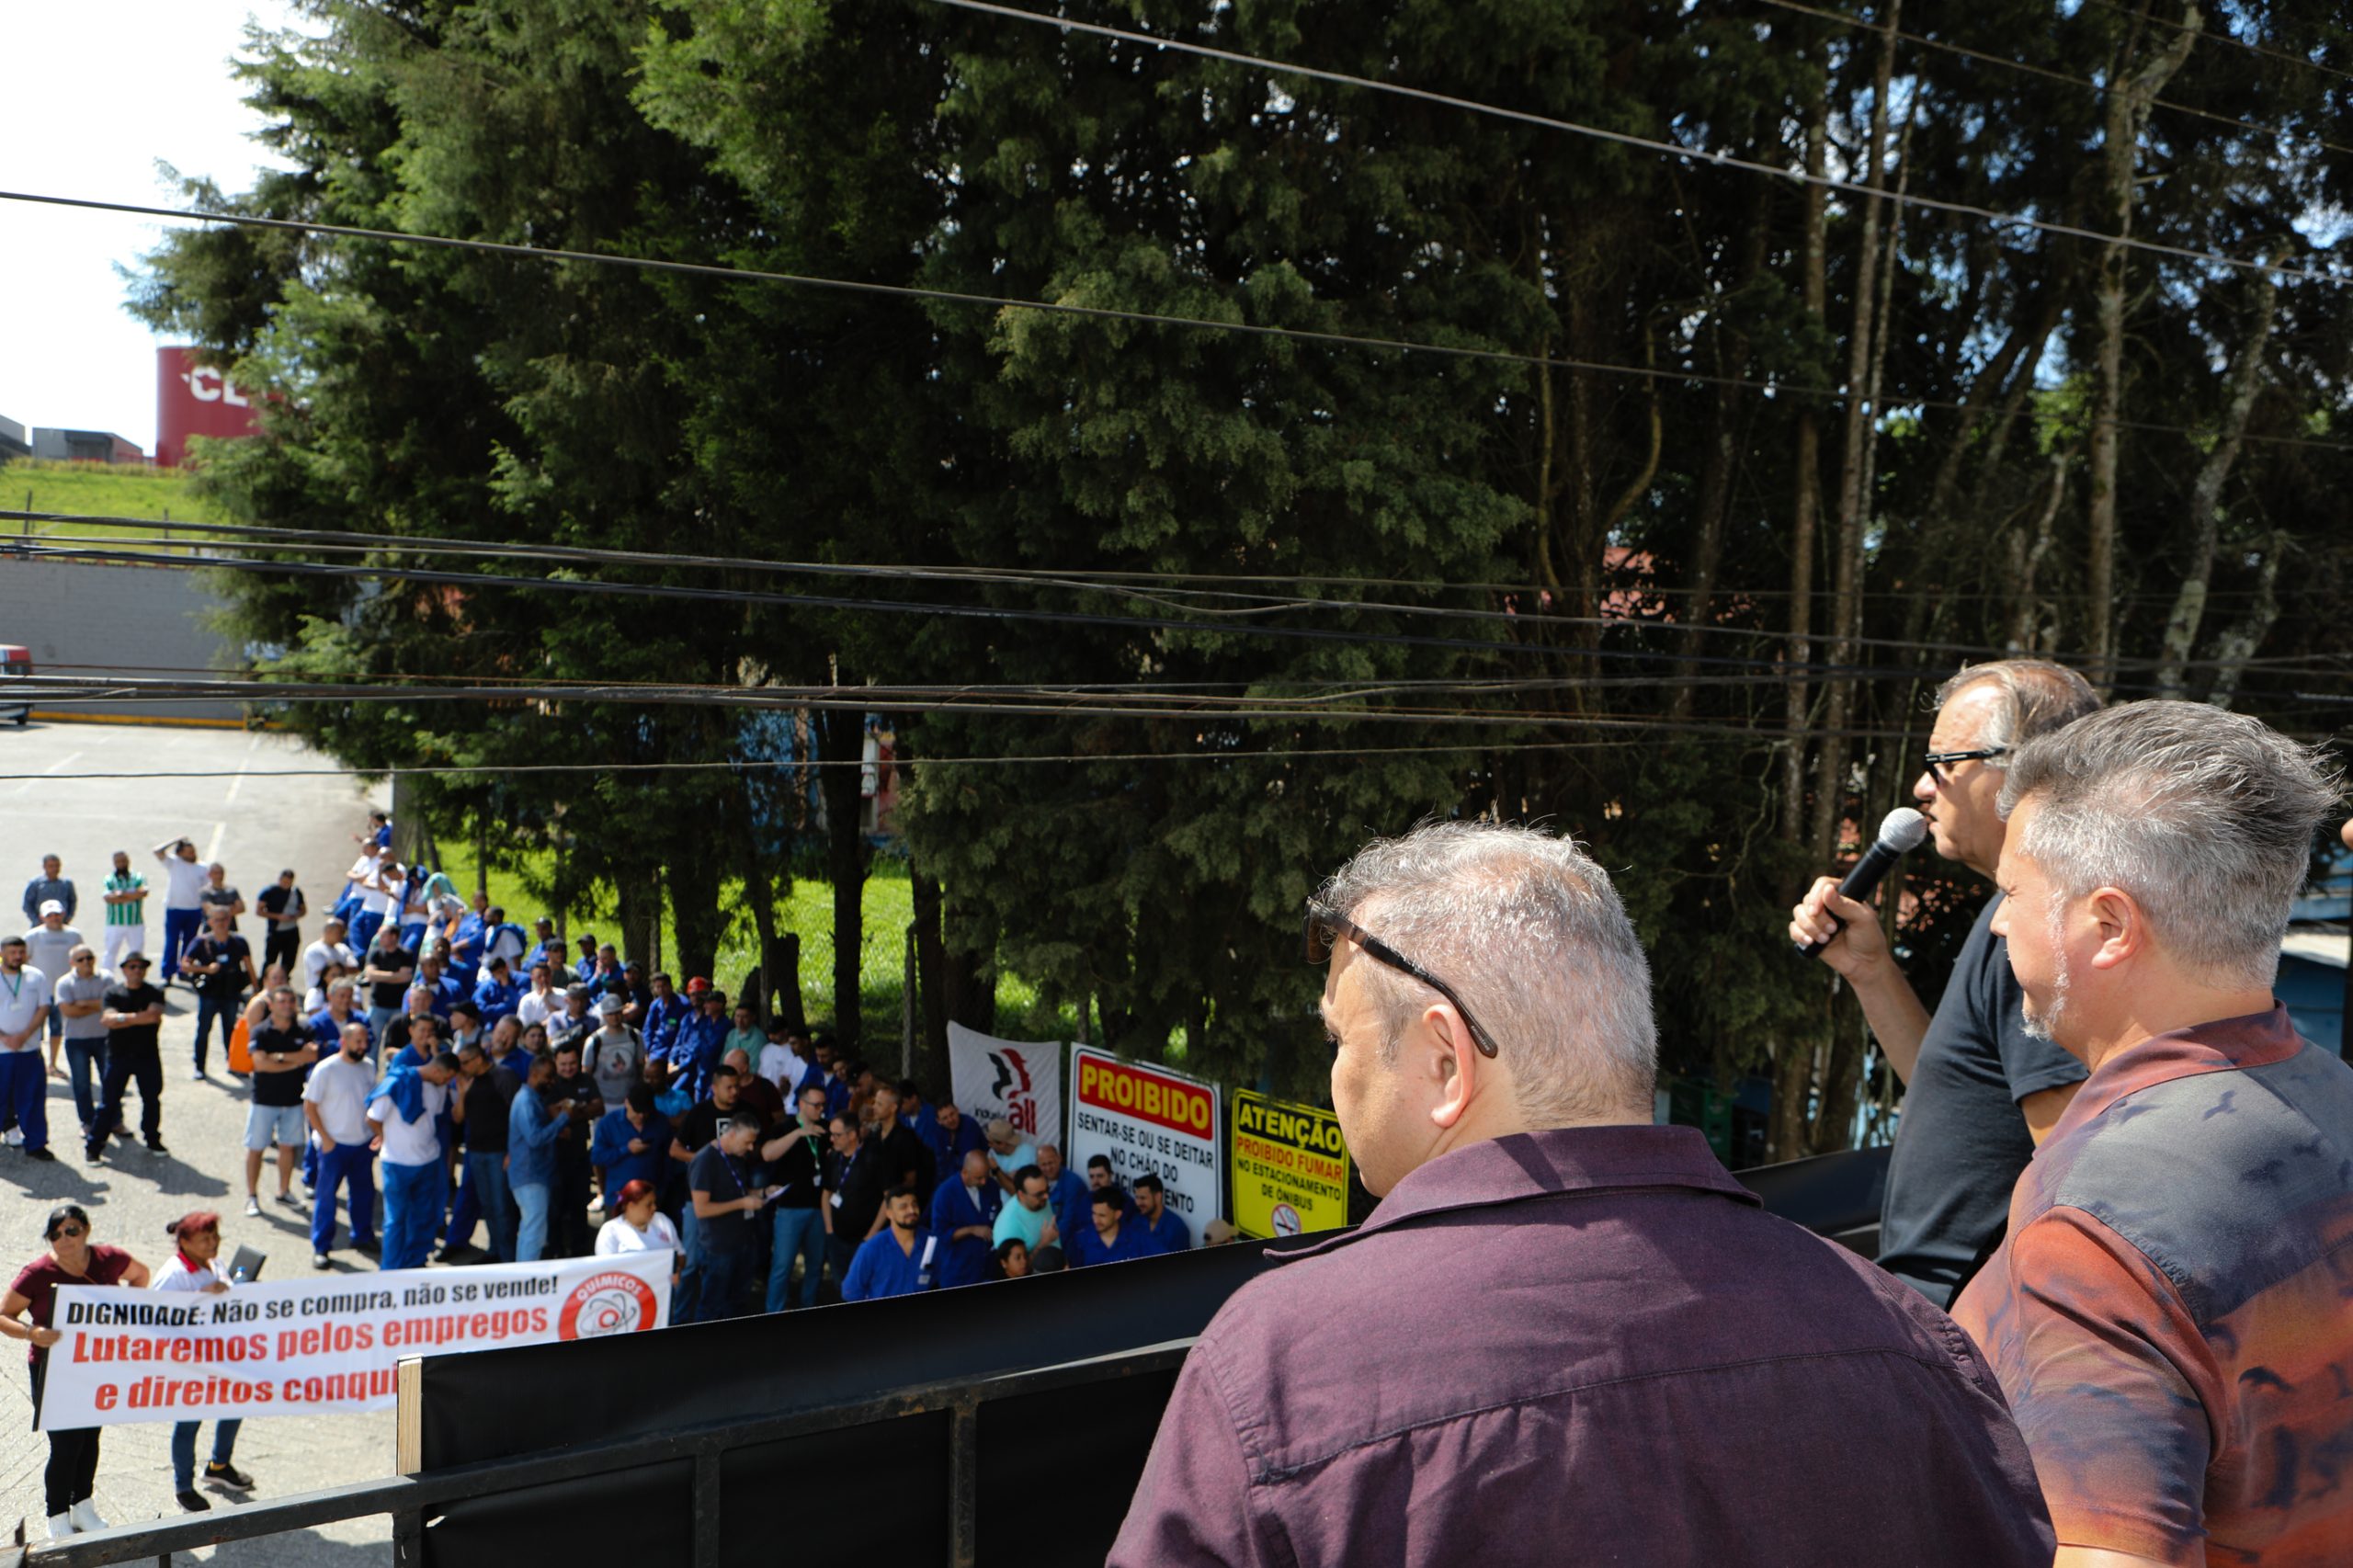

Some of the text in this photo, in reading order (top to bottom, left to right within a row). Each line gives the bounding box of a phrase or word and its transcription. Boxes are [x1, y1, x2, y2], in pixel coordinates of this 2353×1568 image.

[1081, 1063, 1210, 1131] PROIBIDO
[1077, 1112, 1213, 1169] SENTAR-SE OU SE DEITAR
[1238, 1103, 1342, 1153] ATENÇÃO
[1110, 1146, 1177, 1183] NO CHÃO DO
[1237, 1136, 1343, 1182] PROIBIDO FUMAR
[1238, 1158, 1341, 1201] NO ESTACIONAMENTO
[1261, 1183, 1313, 1211] DE ÔNIBUS
[66, 1275, 558, 1326] DIGNIDADE: Não se compra, não se vende!
[73, 1306, 549, 1363] Lutaremos pelos empregos
[95, 1362, 398, 1411] e direitos conqui
